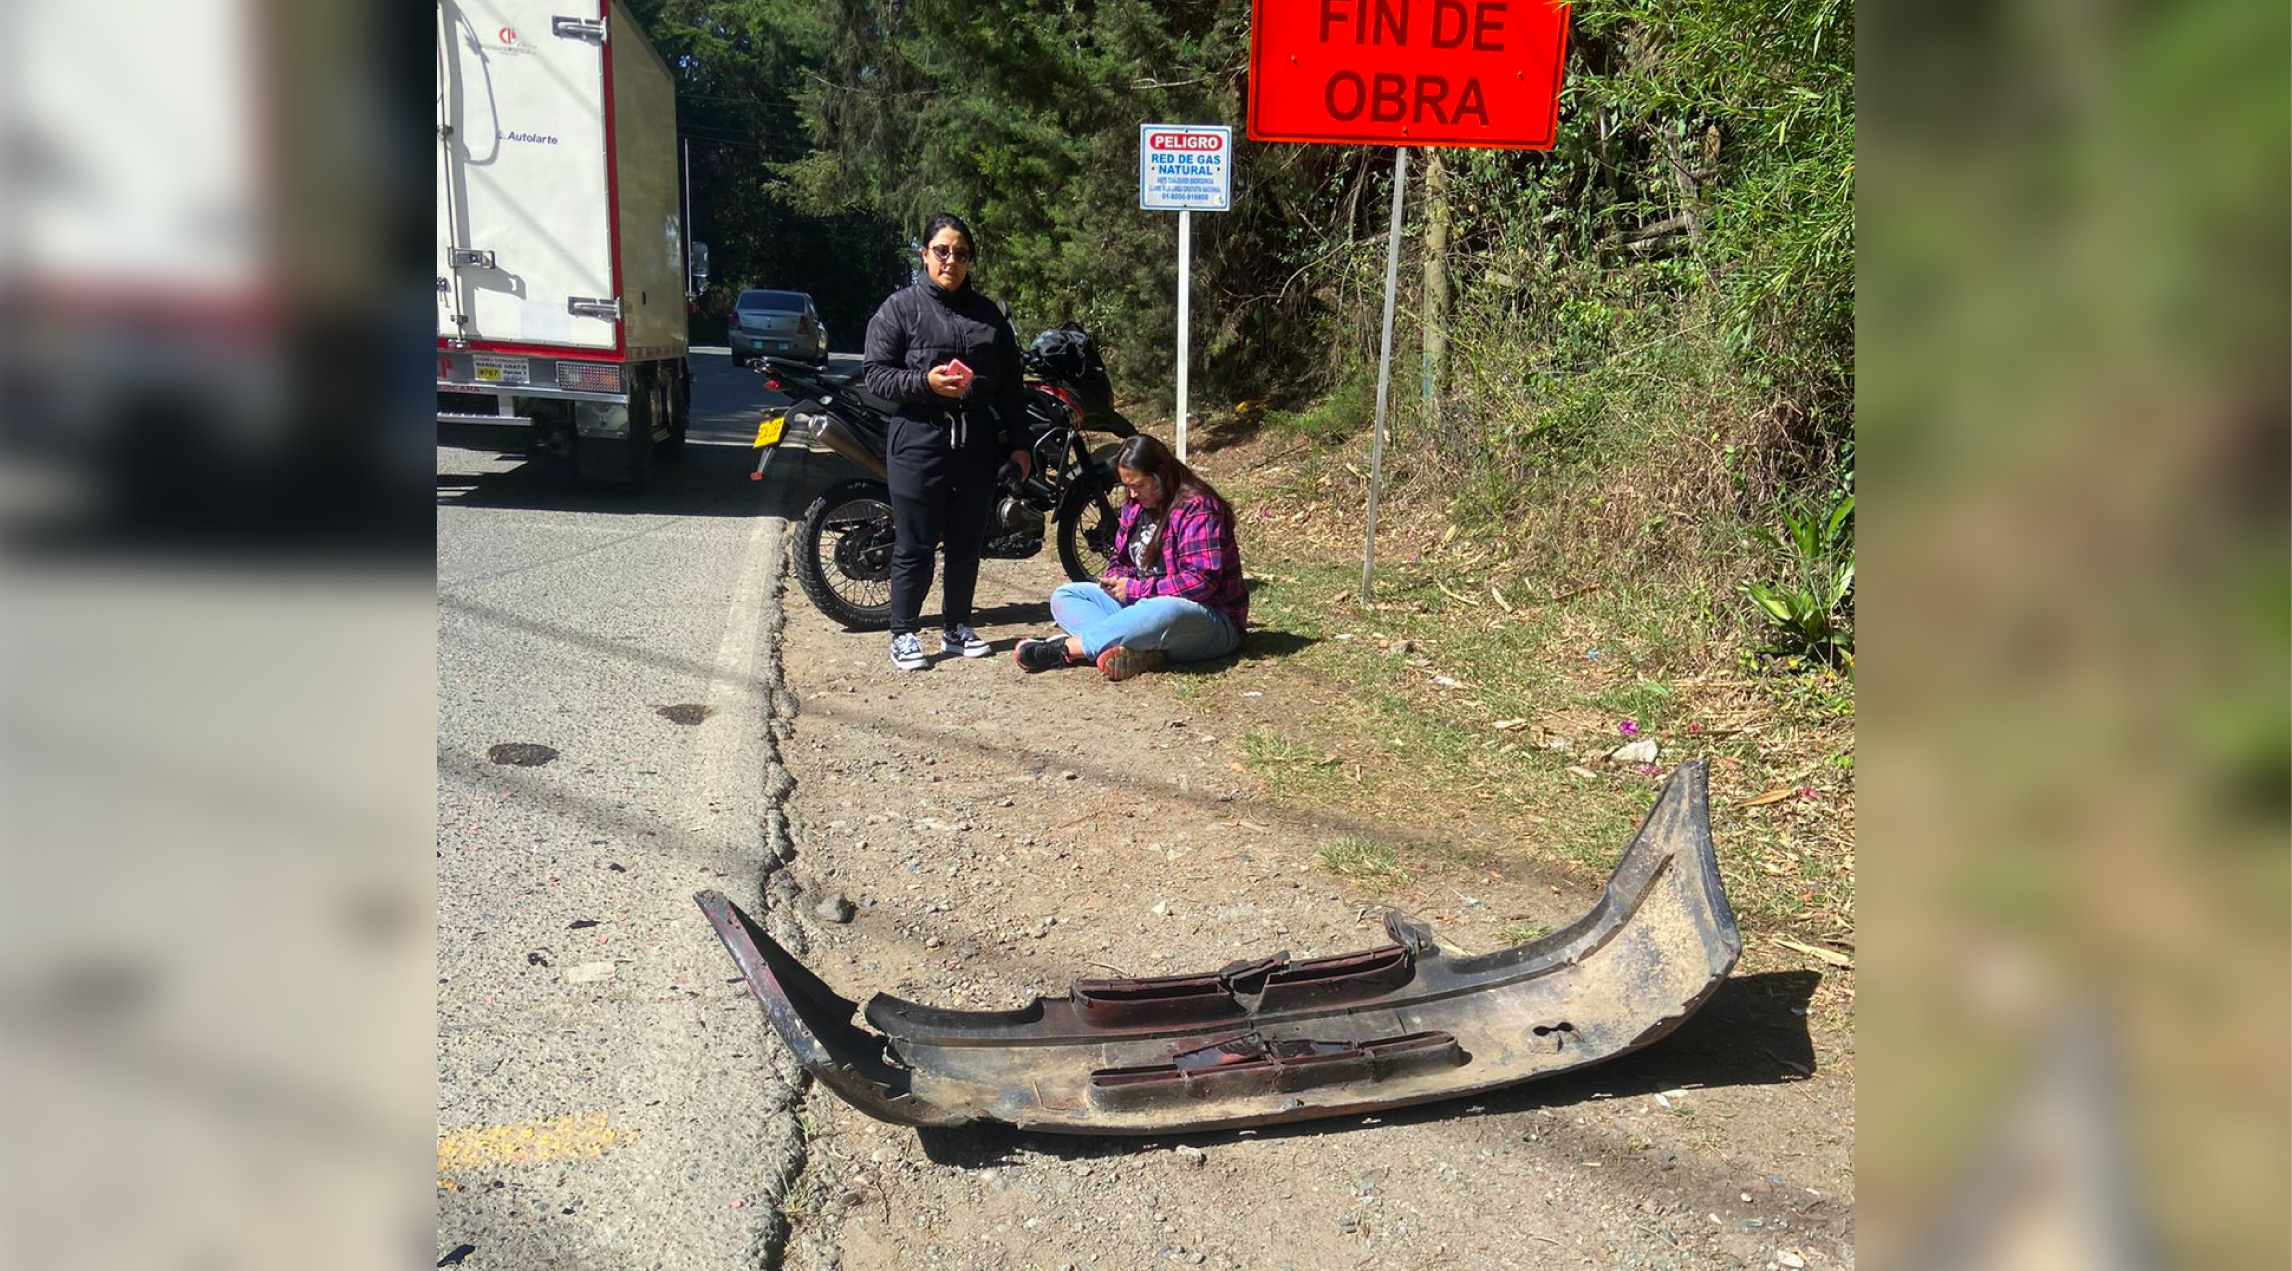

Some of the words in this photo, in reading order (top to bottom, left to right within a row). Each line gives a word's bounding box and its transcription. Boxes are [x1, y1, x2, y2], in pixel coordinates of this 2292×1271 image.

[1319, 0, 1410, 46] FIN
[1431, 0, 1507, 52] DE
[1324, 70, 1489, 126] OBRA
[508, 131, 558, 145] Autolarte
[1154, 136, 1218, 149] PELIGRO
[1151, 153, 1174, 164] RED
[1179, 154, 1193, 164] DE
[1197, 155, 1221, 165] GAS
[1158, 165, 1213, 175] NATURAL
